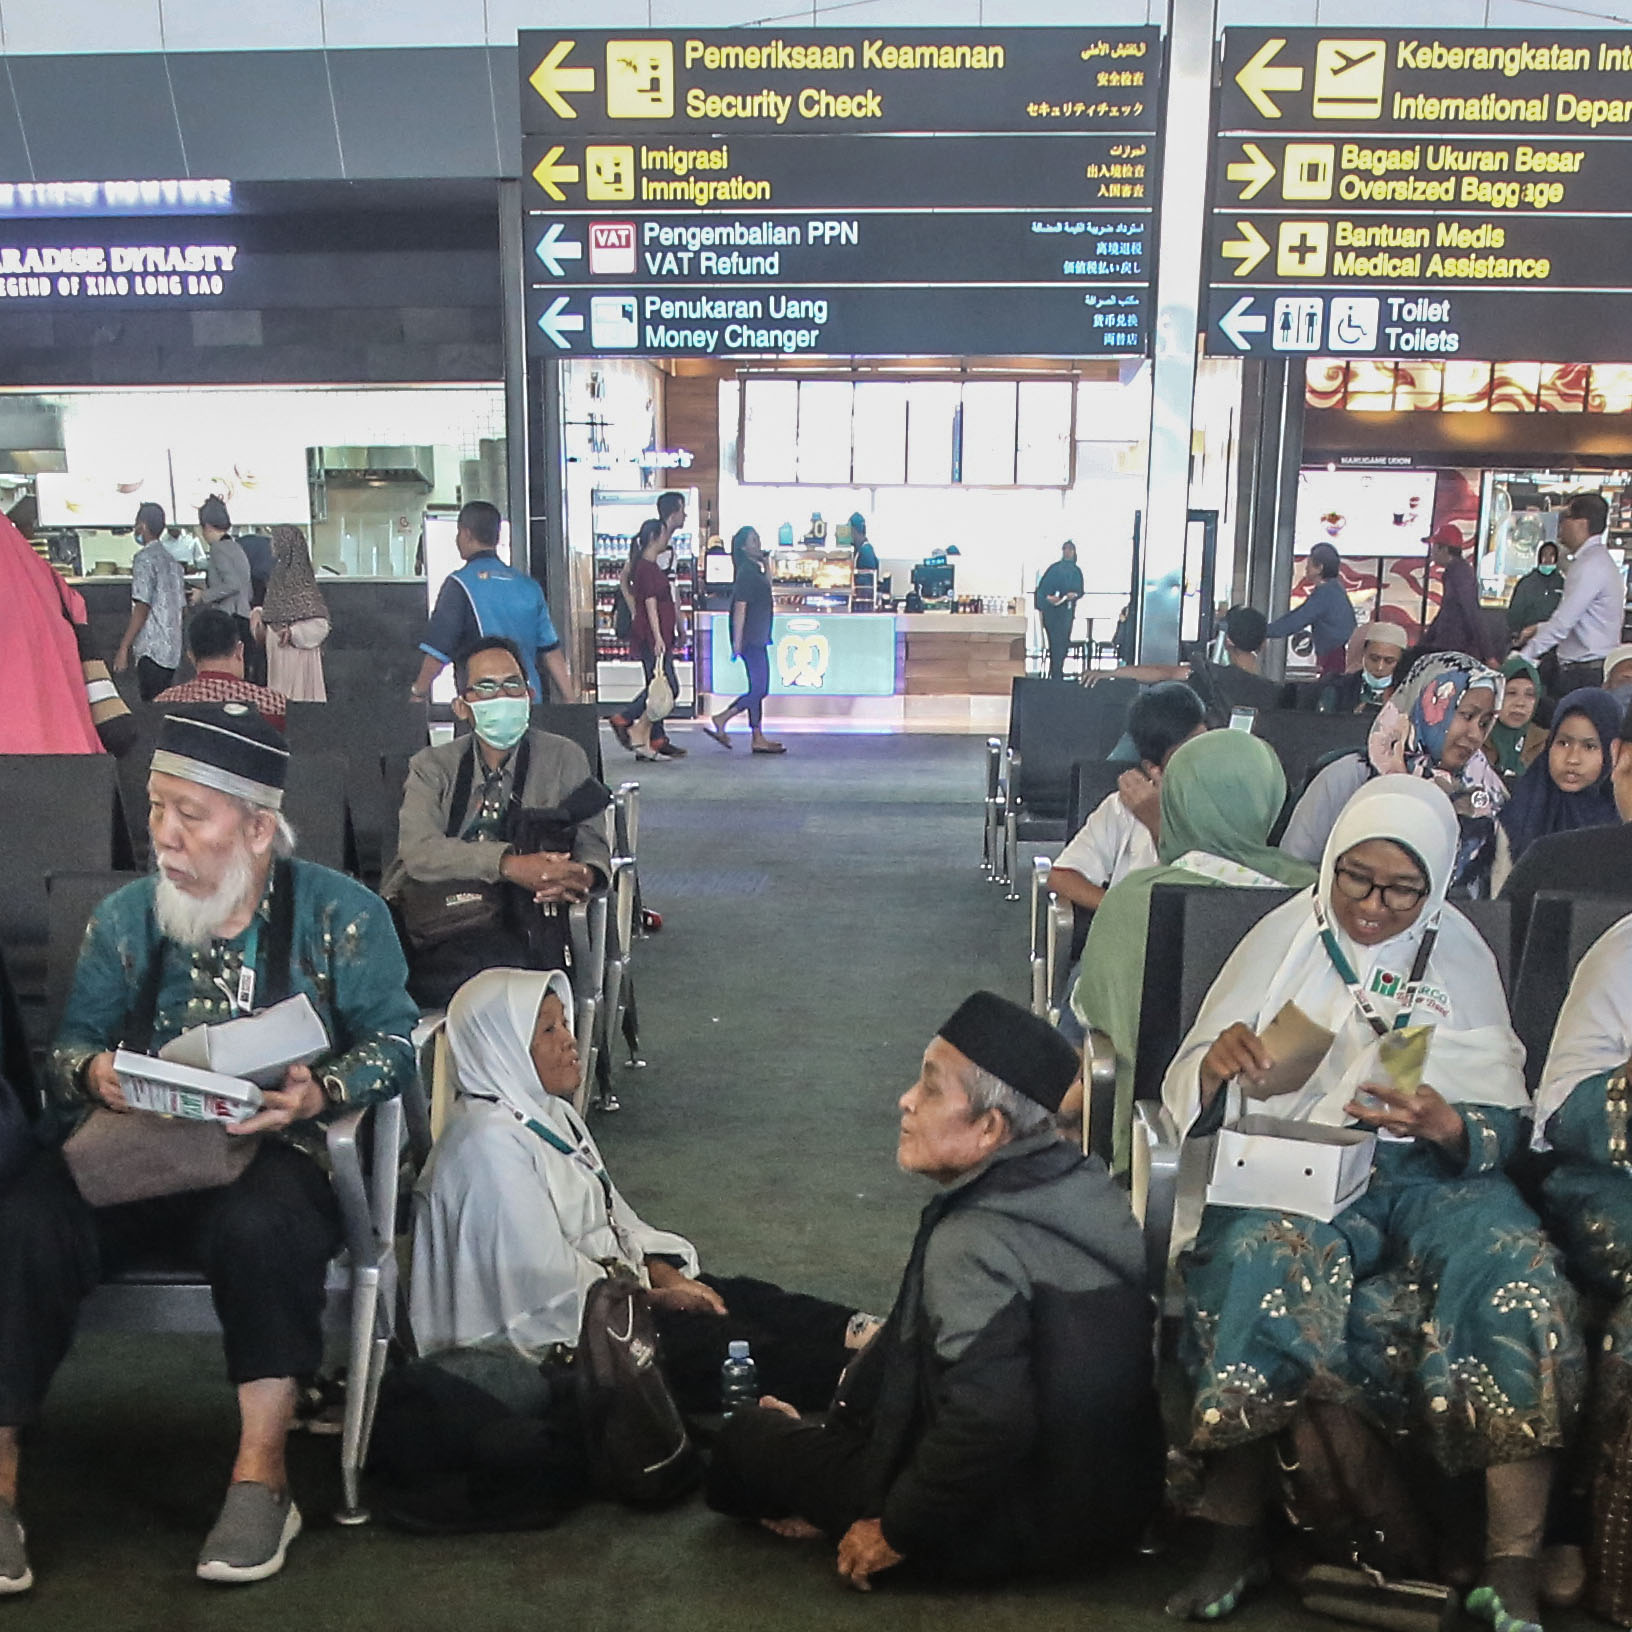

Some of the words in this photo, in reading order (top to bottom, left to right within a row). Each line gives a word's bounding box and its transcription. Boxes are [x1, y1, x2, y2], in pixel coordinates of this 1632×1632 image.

[685, 39, 855, 69] Pemeriksaan
[863, 39, 1004, 69] Keamanan
[1397, 39, 1591, 77] Keberangkatan
[686, 88, 792, 125] Security
[798, 88, 882, 118] Check
[1026, 101, 1144, 117] セキュリティチェック
[1392, 91, 1550, 122] International
[641, 144, 728, 179] Imigrasi
[1341, 143, 1421, 178] Bagasi
[1426, 145, 1509, 172] Ukuran
[1514, 146, 1585, 173] Besar
[641, 177, 771, 205] Immigration
[1340, 177, 1455, 201] Oversized
[1460, 175, 1564, 209] Baggage
[593, 227, 632, 249] VAT
[644, 221, 801, 254] Pengembalian
[808, 220, 858, 245] PPN
[1335, 221, 1430, 248] Bantuan
[1436, 221, 1505, 249] Medis
[110, 246, 236, 273] DYNASTY
[644, 249, 696, 275] VAT
[700, 251, 779, 275] Refund
[1333, 251, 1421, 278] Medical
[1425, 252, 1550, 279] Assistance
[57, 276, 80, 296] OF
[85, 276, 129, 296] XIAO
[134, 275, 182, 295] LONG
[188, 275, 223, 295] BAO
[645, 295, 762, 319] Penukaran
[769, 295, 828, 324] Uang
[1387, 297, 1451, 322] Toilet
[645, 325, 718, 351] Money
[724, 324, 820, 350] Changer
[1384, 327, 1459, 352] Toilets
